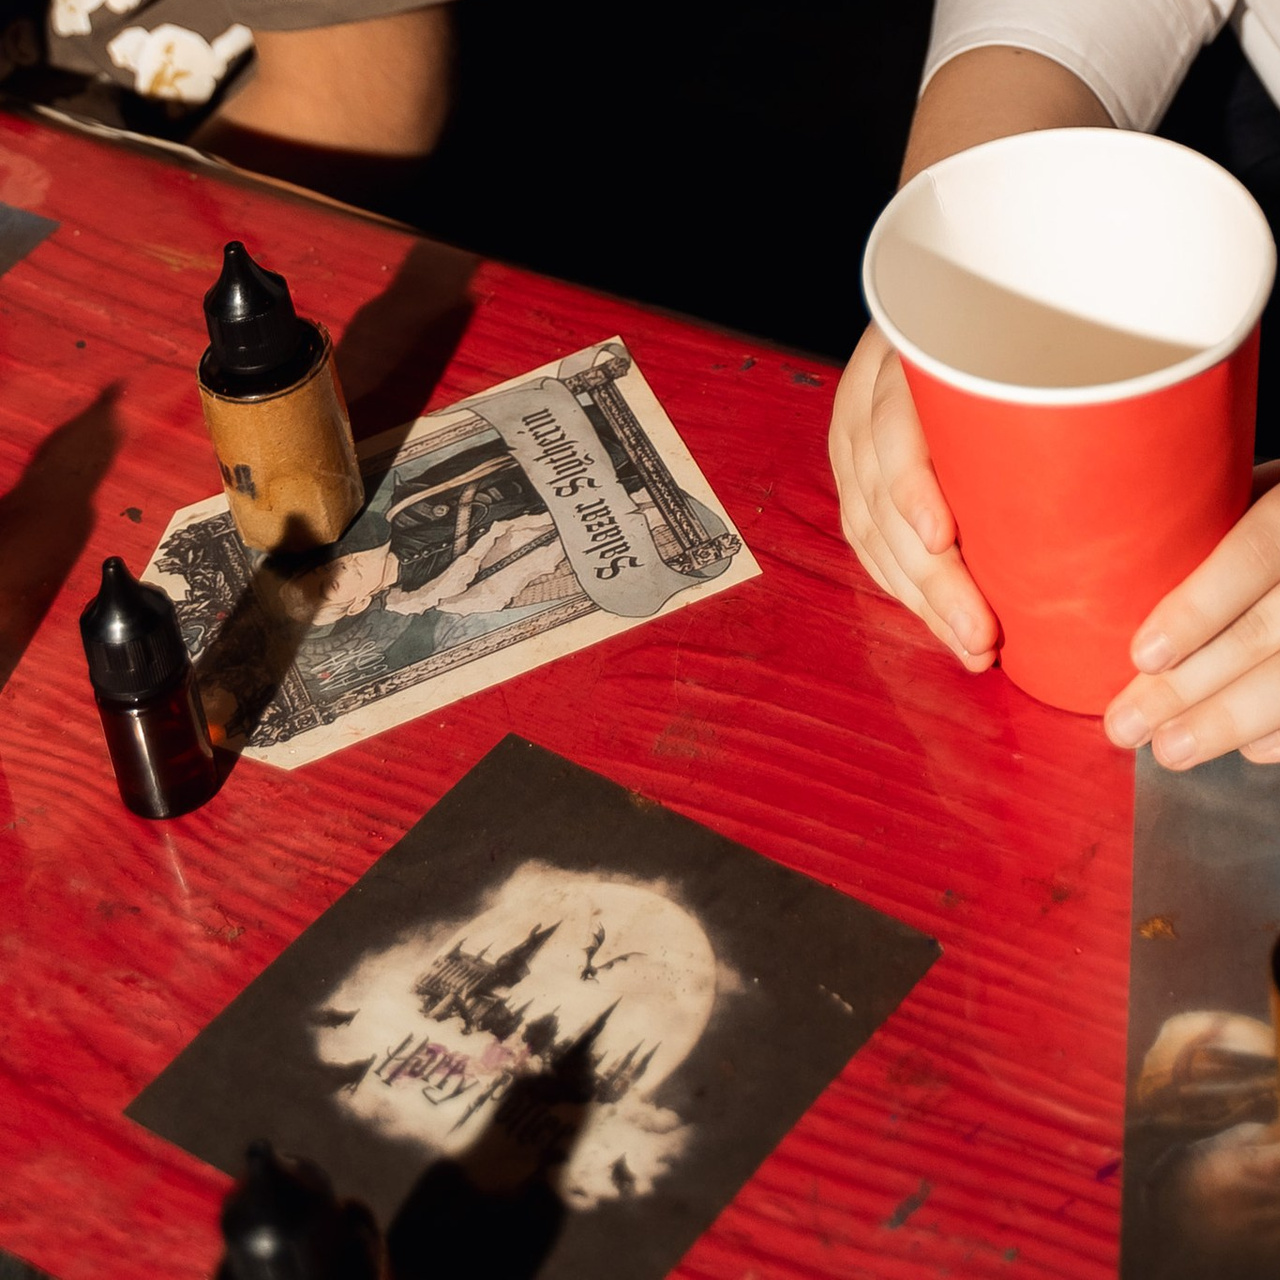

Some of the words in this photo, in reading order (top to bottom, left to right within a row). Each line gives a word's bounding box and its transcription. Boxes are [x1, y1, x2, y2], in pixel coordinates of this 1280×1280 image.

[516, 406, 602, 498] Slytherin
[575, 496, 645, 581] Salazar
[373, 1031, 479, 1107] Harry
